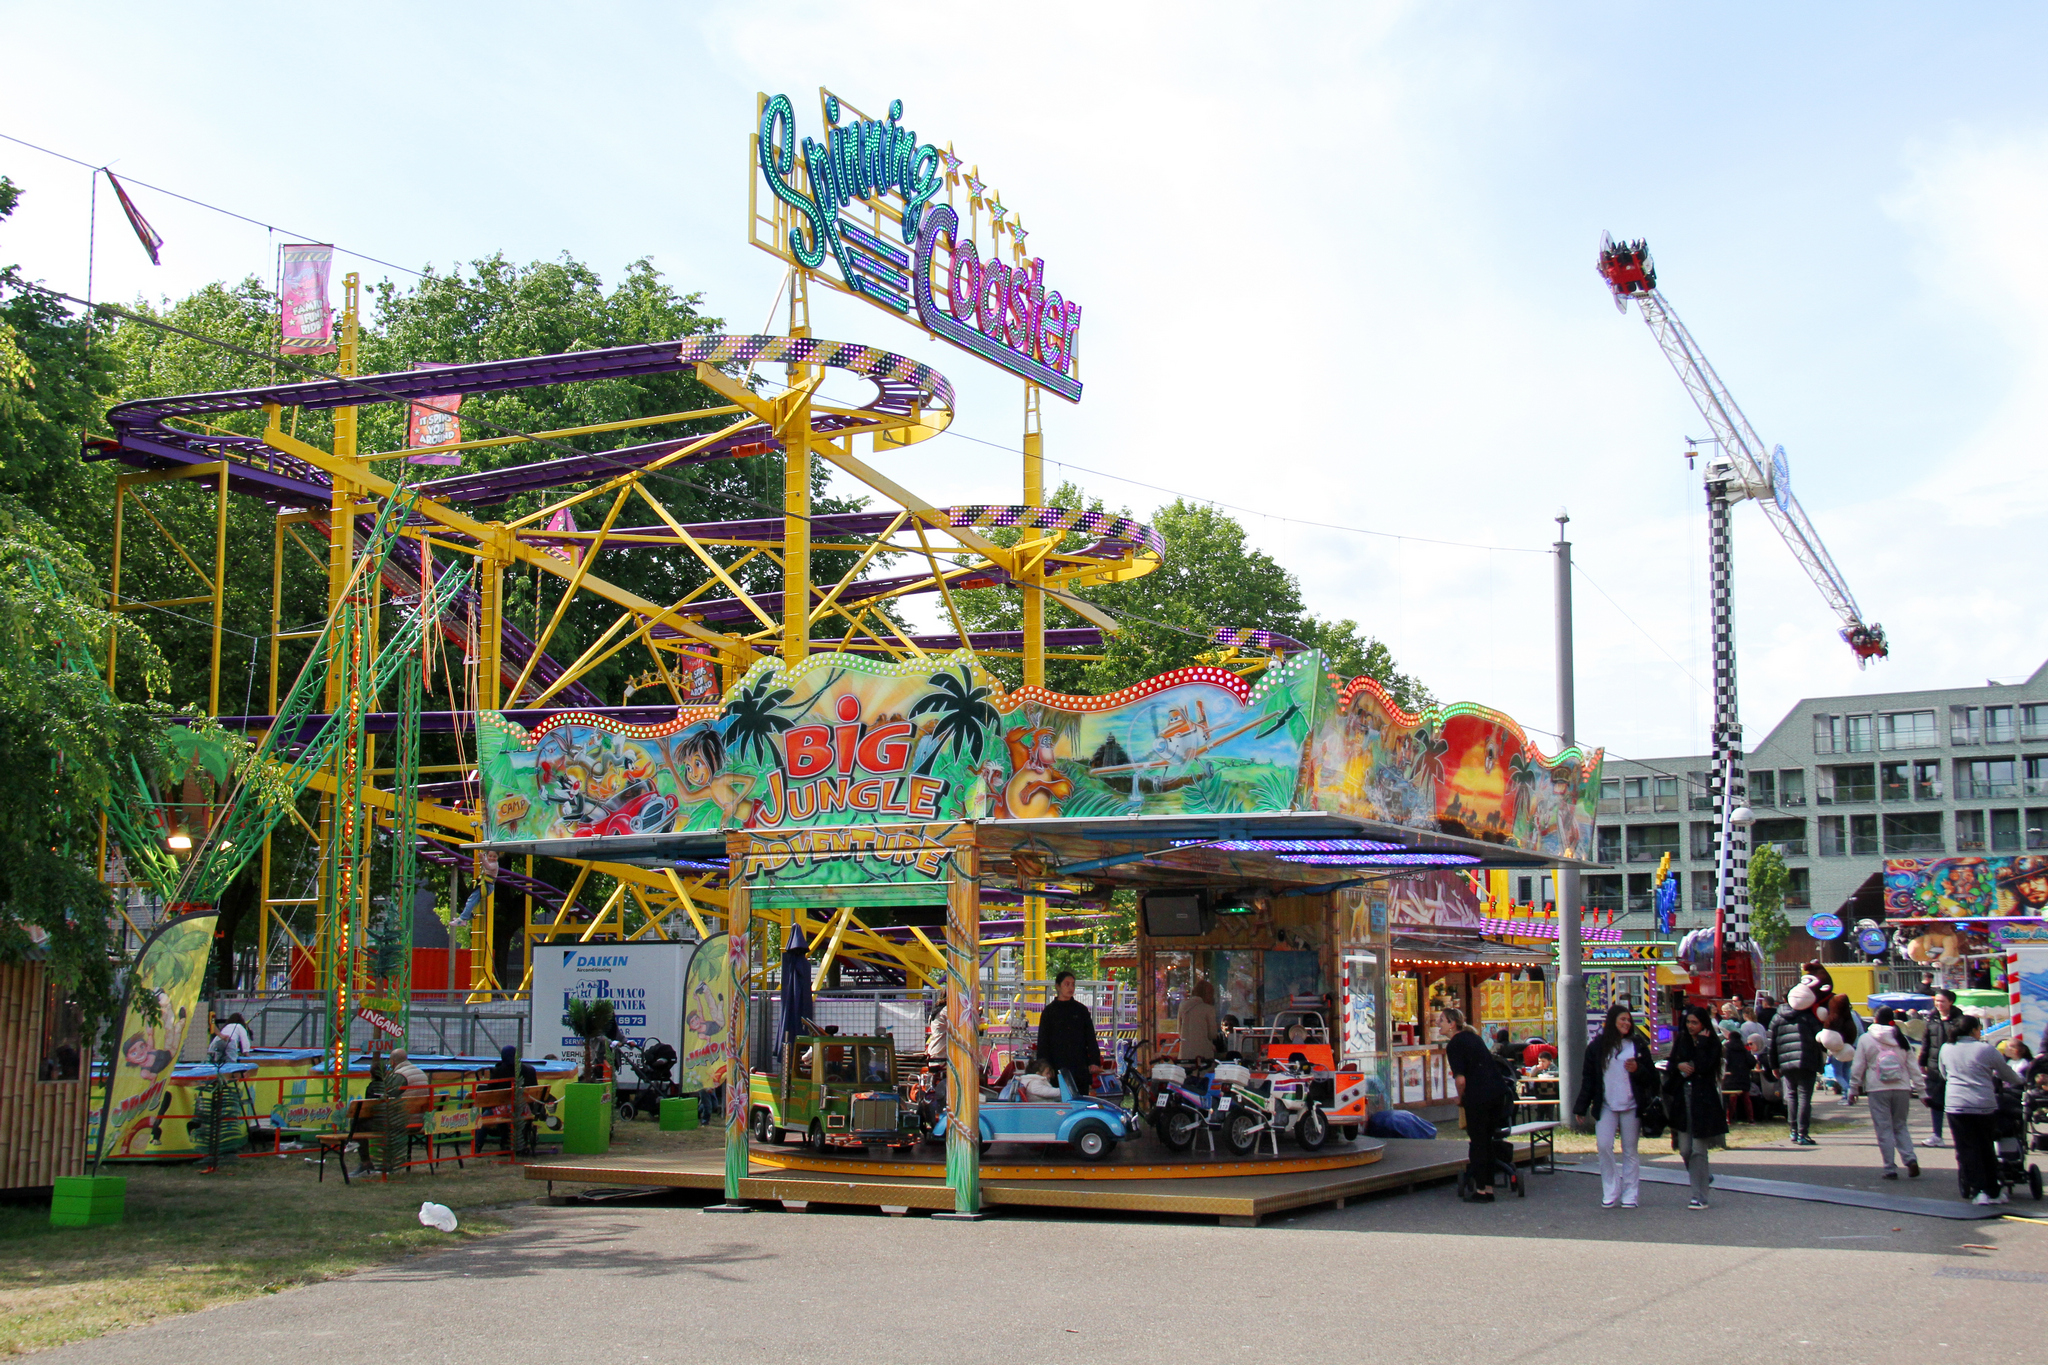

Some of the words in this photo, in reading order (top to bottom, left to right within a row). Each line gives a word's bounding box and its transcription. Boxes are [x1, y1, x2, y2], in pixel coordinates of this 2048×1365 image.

[760, 93, 943, 290] Spinning
[914, 203, 1083, 400] Coaster
[419, 416, 428, 426] IT
[427, 423, 445, 434] YOU
[419, 430, 455, 445] AROUND
[500, 799, 526, 815] CAMP
[755, 767, 949, 828] JUNGLE
[745, 827, 950, 880] ADVENTURE
[577, 956, 629, 967] DAIKIN
[1587, 974, 1602, 1010] MEGA
[361, 1009, 402, 1037] INGANG
[367, 1040, 394, 1052] FUN
